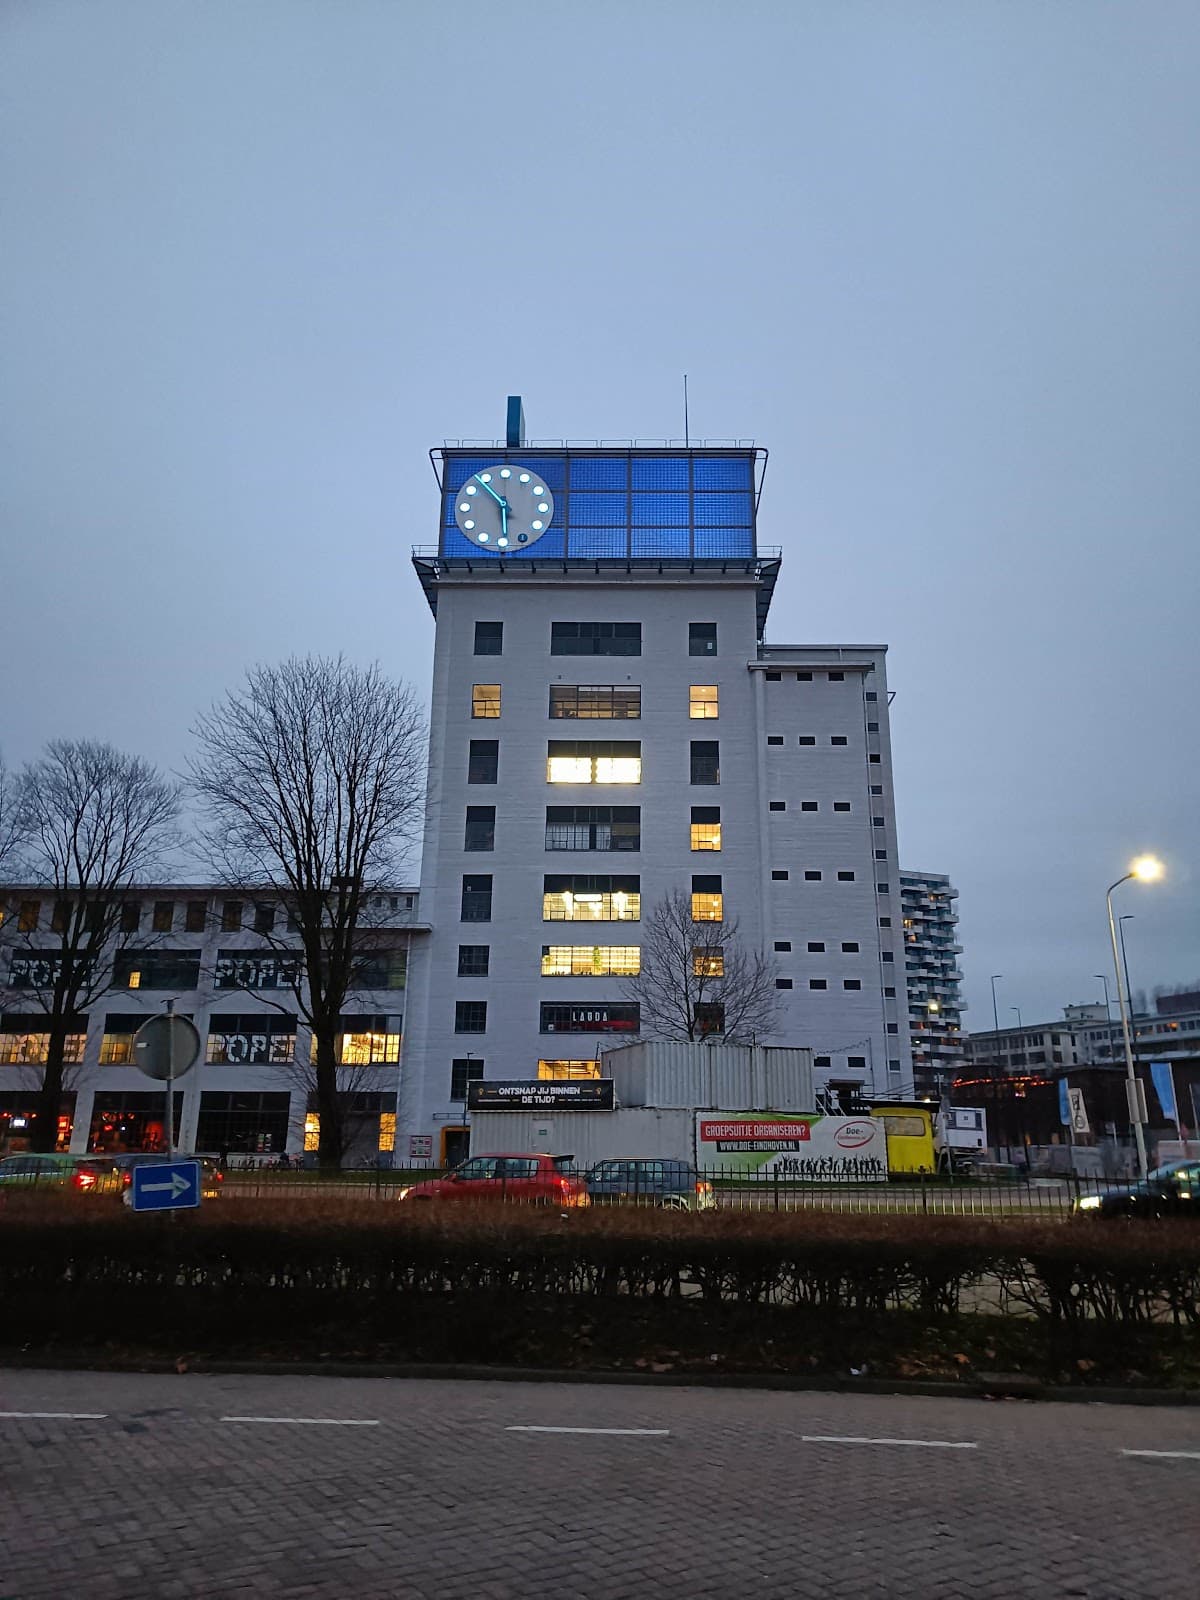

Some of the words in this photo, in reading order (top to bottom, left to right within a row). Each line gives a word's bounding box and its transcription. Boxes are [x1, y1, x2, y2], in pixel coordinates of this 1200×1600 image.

[498, 1087, 536, 1096] ONTSNAP
[537, 1087, 549, 1095] JIJ
[550, 1086, 581, 1095] BINNEN
[522, 1095, 533, 1104] DE
[534, 1095, 556, 1104] TIJD?
[705, 1124, 752, 1137] GROEPSUITJE
[753, 1123, 806, 1137] ORGANISEREN?
[720, 1141, 797, 1152] WWW.DOE-EINDHOVEN.NL
